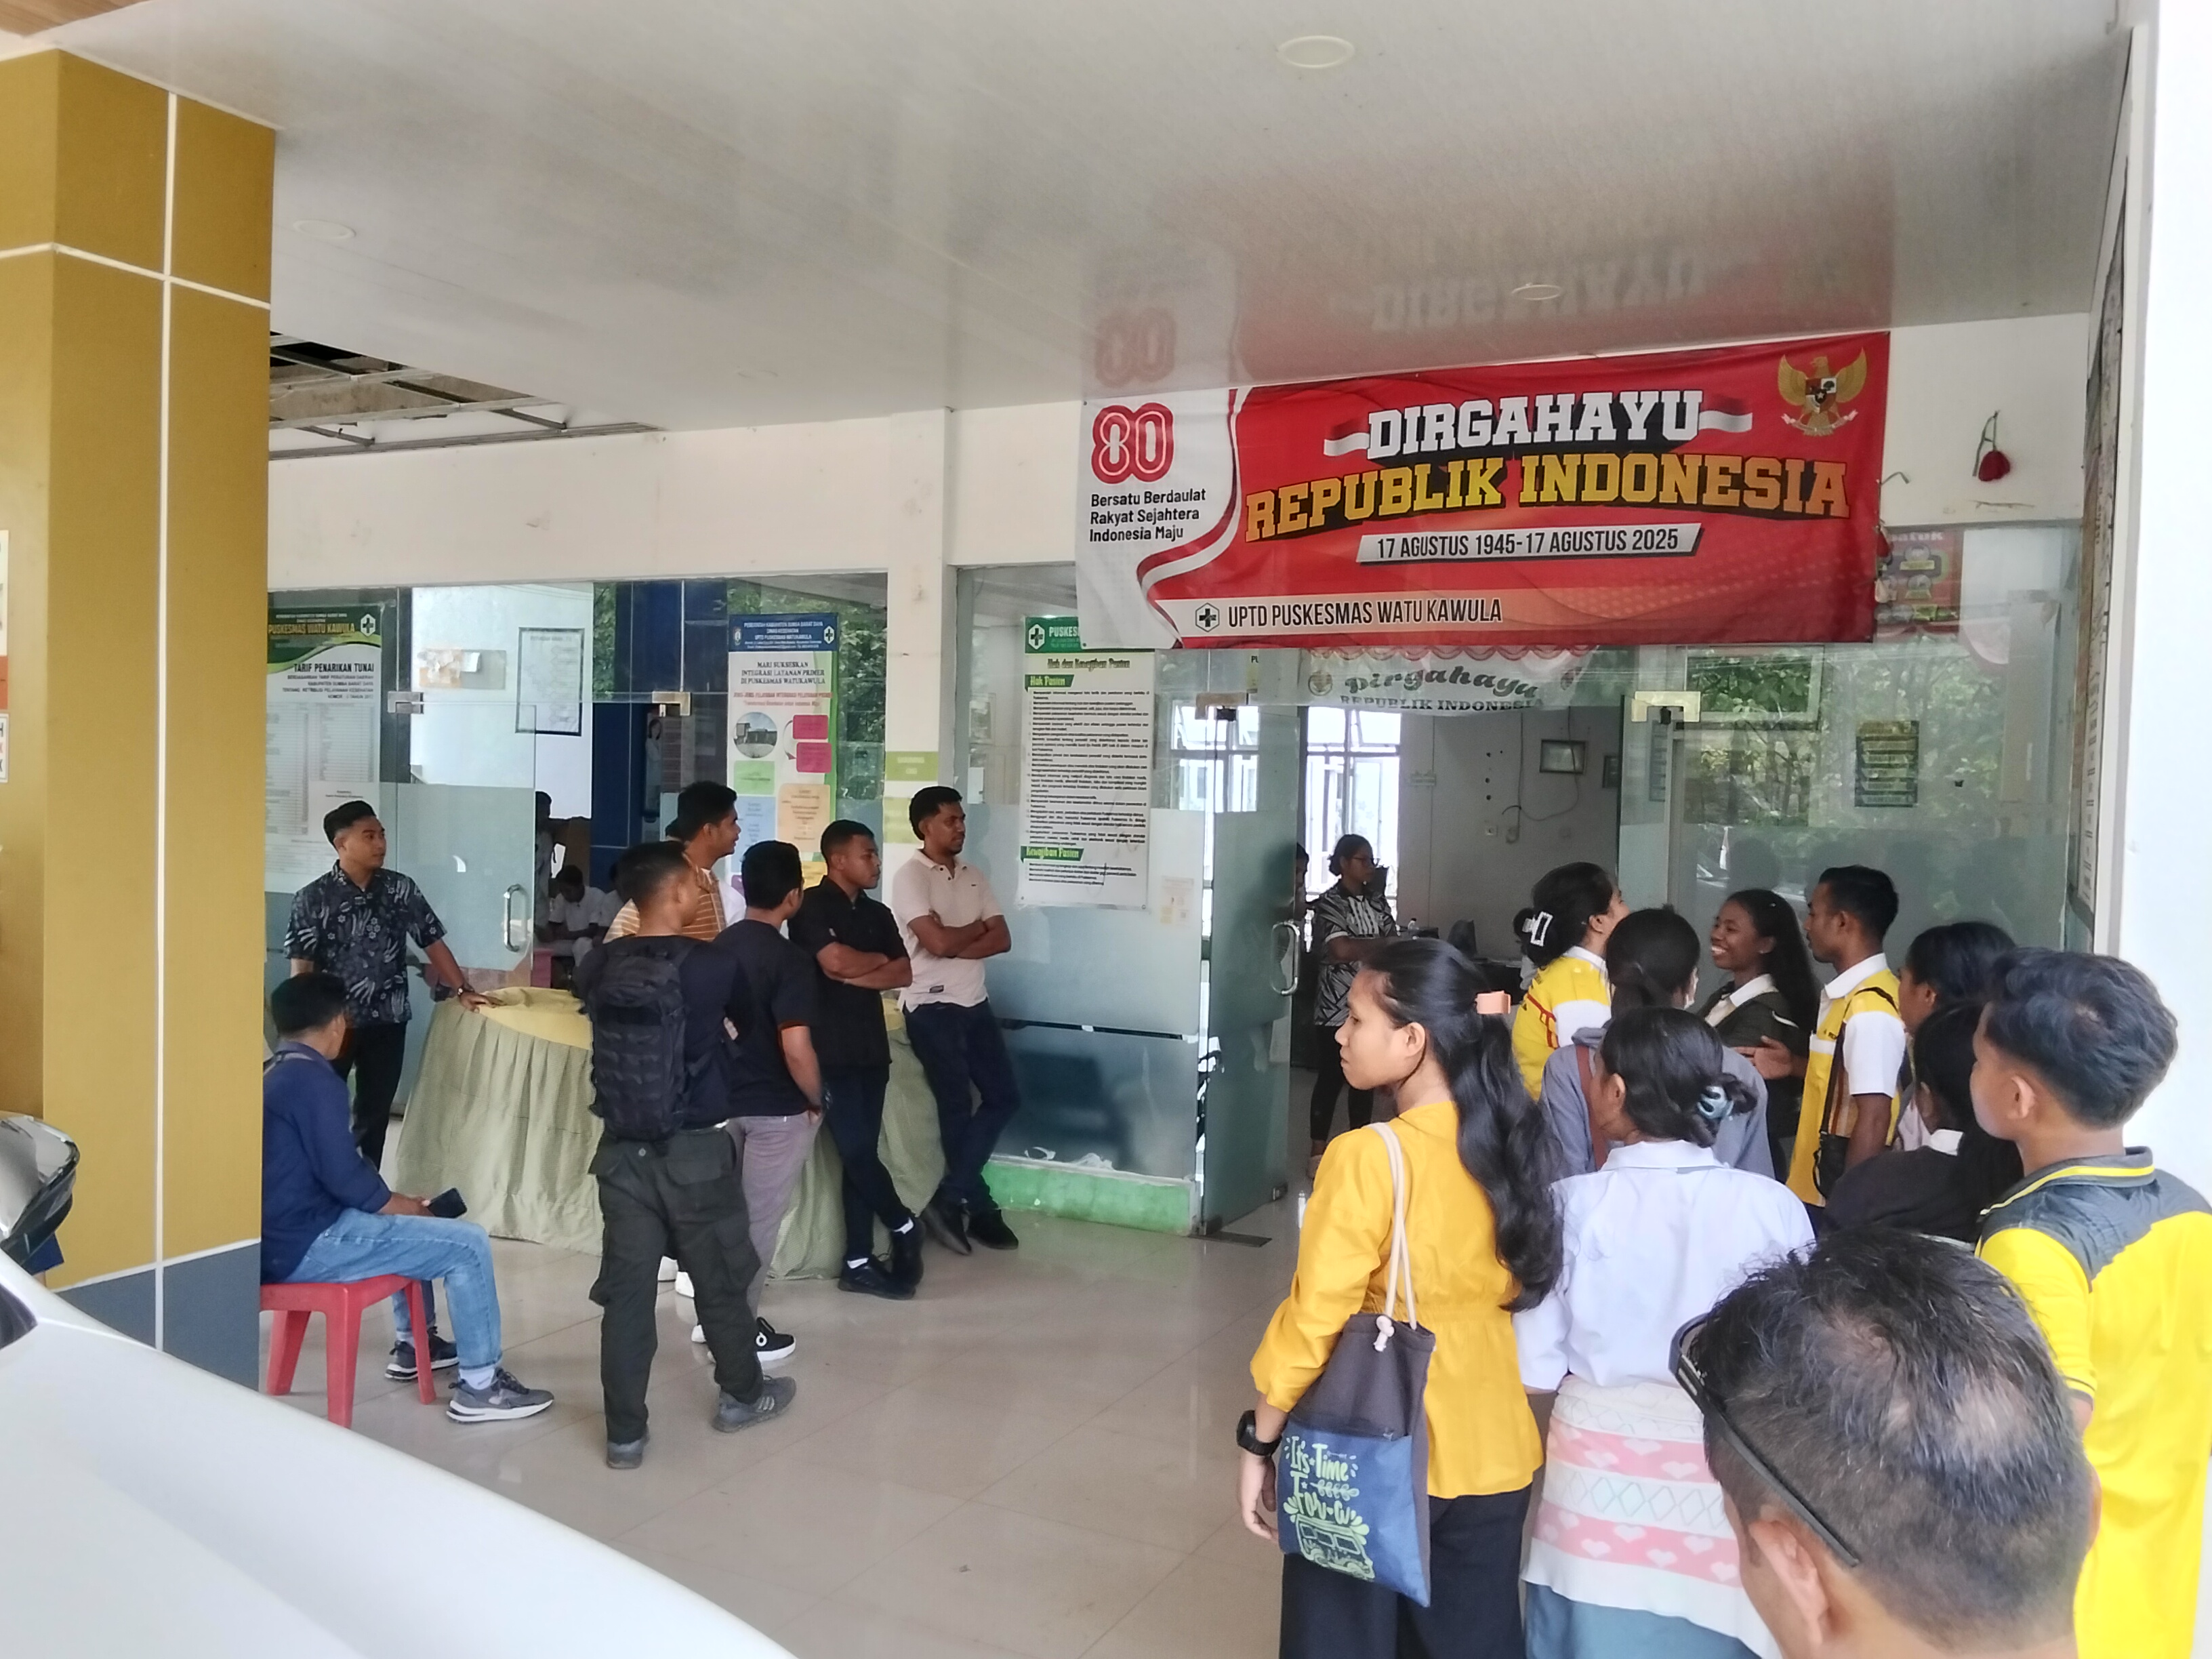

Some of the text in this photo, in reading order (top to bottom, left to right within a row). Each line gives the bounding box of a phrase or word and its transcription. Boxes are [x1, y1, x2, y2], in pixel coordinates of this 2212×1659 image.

[1367, 390, 1703, 459] DIRGAHAYU
[1091, 402, 1174, 484] 80
[1091, 488, 1206, 507] Bersatu Berdaulat
[1245, 453, 1849, 543] REPUBLIK INDONESIA
[1090, 508, 1200, 527] Rakyat Sejahtera
[1090, 525, 1183, 541] Indonesia Maju
[1377, 537, 1395, 558] 17
[1400, 535, 1469, 558] AGUSTUS
[1549, 531, 1627, 553] AGUSTUS
[1632, 528, 1679, 550] 2025
[1228, 598, 1503, 628] UPTD PUSKESMAS WATU KAWULA
[1049, 626, 1079, 637] PUSKES
[294, 663, 374, 672] TARIF PENARIKAN TUNAI
[1030, 676, 1043, 686] Hak
[1312, 1443, 1349, 1481] Time
